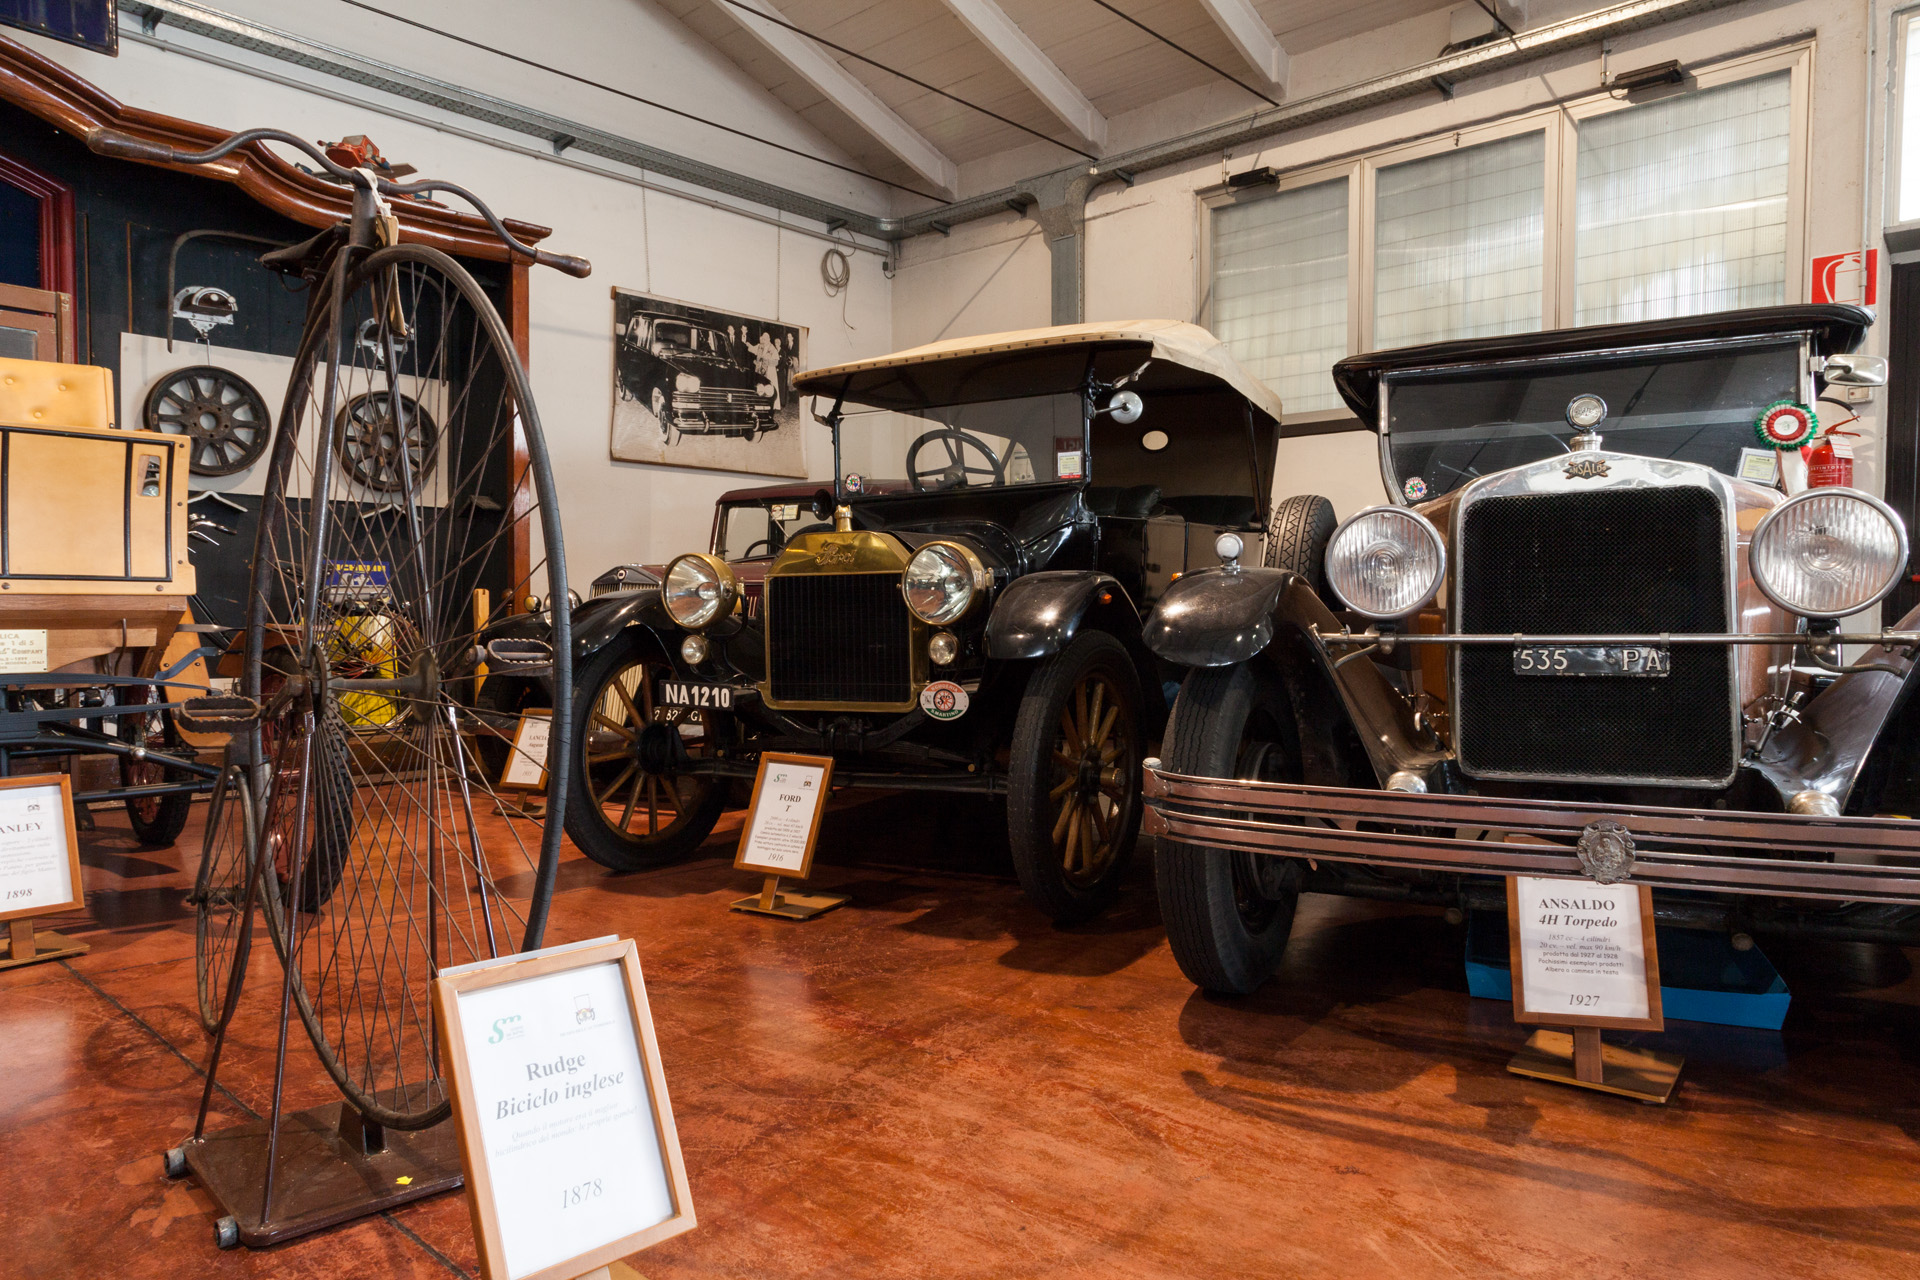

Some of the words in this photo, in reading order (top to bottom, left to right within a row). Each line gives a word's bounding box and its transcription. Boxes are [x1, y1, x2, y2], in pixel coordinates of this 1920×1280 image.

[1569, 461, 1607, 477] ANSALDO
[1520, 650, 1568, 670] 535
[779, 794, 801, 803] FORD
[768, 852, 784, 862] 1916
[6, 888, 33, 900] 1898
[1539, 898, 1615, 911] ANSALDO
[1539, 914, 1559, 925] 4H
[1564, 915, 1618, 929] Torpedo
[1569, 994, 1600, 1007] 1927
[526, 1053, 586, 1082] Rudge
[496, 1087, 559, 1120] Biciclo
[565, 1070, 624, 1100] inglese
[512, 1123, 541, 1142] Quando
[549, 1116, 573, 1129] motore
[562, 1178, 603, 1209] 1878
